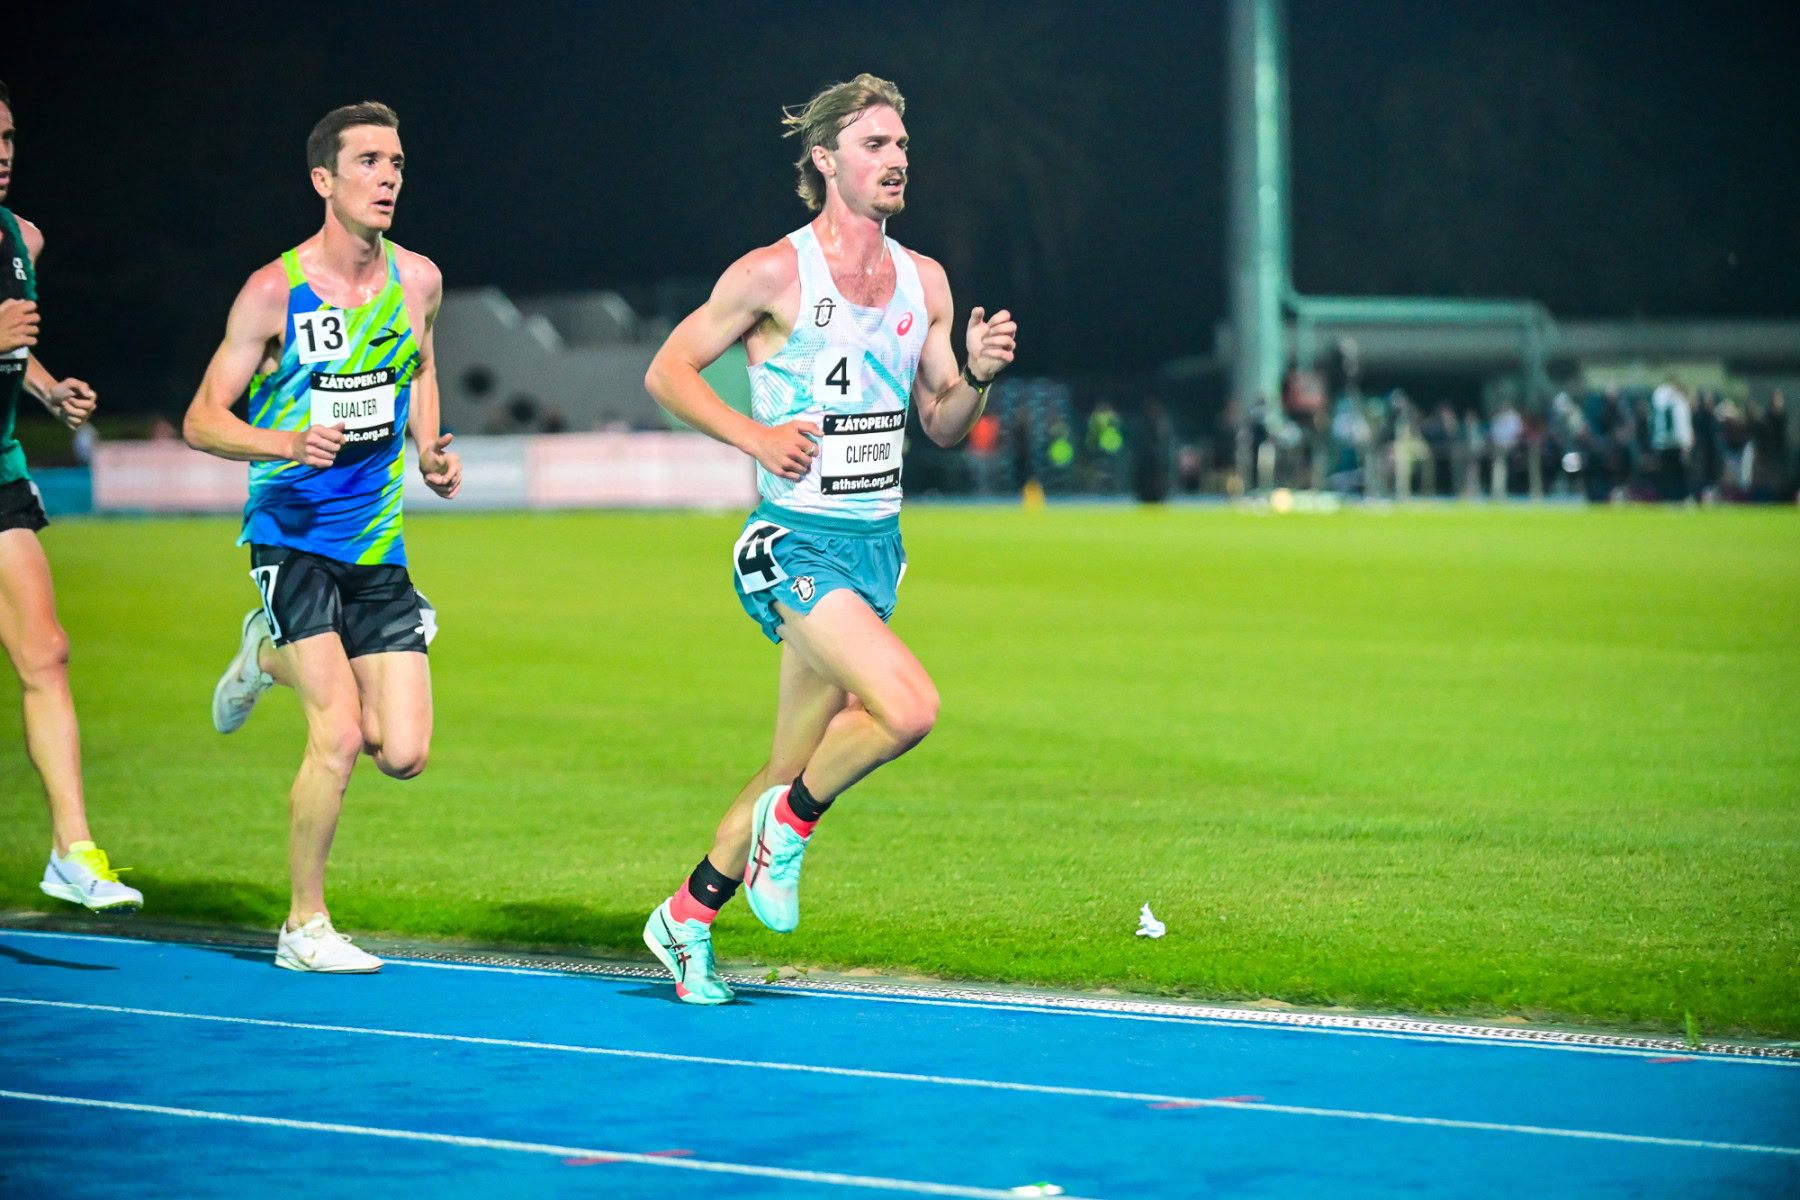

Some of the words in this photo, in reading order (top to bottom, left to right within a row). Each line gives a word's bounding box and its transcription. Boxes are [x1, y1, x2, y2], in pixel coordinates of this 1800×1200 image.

[299, 316, 344, 352] 13
[319, 371, 388, 390] ZÁTOPEK:10
[825, 357, 850, 395] 4
[332, 399, 378, 418] GUALTER
[834, 415, 902, 432] ZÁTOPEK:10
[344, 427, 389, 442] vic.org.au
[846, 442, 891, 464] CLIFFORD
[832, 474, 894, 490] athsvic.org.au
[738, 525, 782, 583] 4
